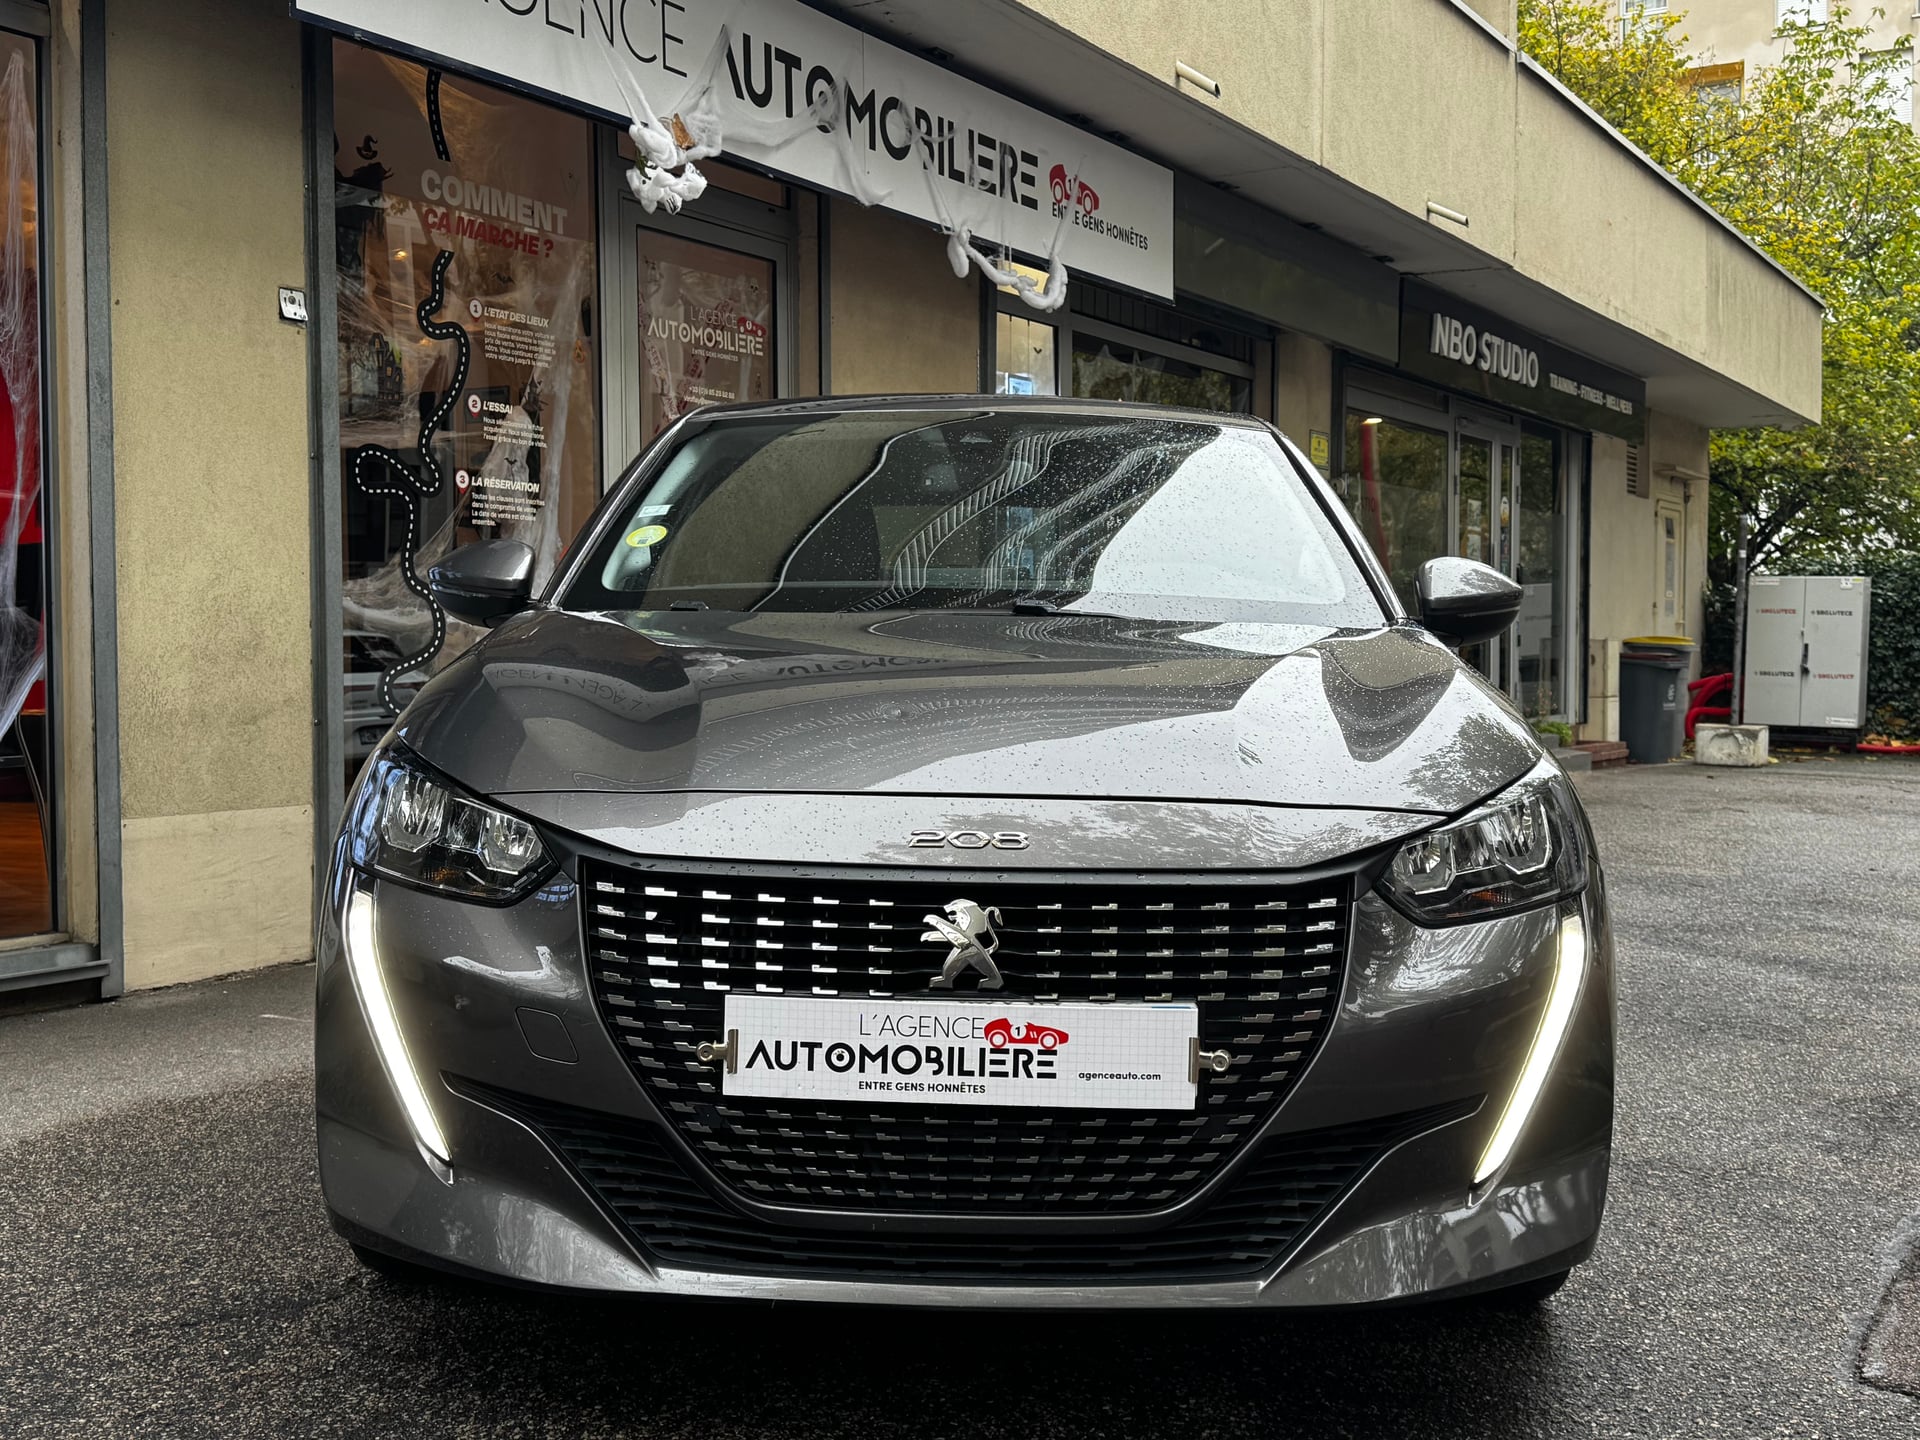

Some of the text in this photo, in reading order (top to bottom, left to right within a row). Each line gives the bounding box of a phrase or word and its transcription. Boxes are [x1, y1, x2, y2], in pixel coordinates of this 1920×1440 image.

[421, 169, 567, 235] COMMENT
[455, 216, 540, 256] MARCHE
[543, 239, 554, 258] ?
[1052, 201, 1148, 251] ENE GENS HONNÊTES
[509, 312, 526, 323] DES
[526, 315, 550, 328] LIEUX
[690, 305, 738, 329] L'AGENCE
[1430, 312, 1539, 388] NBO STUDIO
[483, 400, 513, 414] L'ESSAI
[471, 476, 540, 493] LA RÉSERVATION
[908, 830, 1030, 850] 208
[859, 1013, 985, 1040] L'AGENCE
[1015, 1026, 1021, 1037] 1
[745, 1039, 1058, 1079] AUTOMOBILIERE
[858, 1072, 1161, 1094] ENTRE GENS HONNÊTES agenceauto.com
